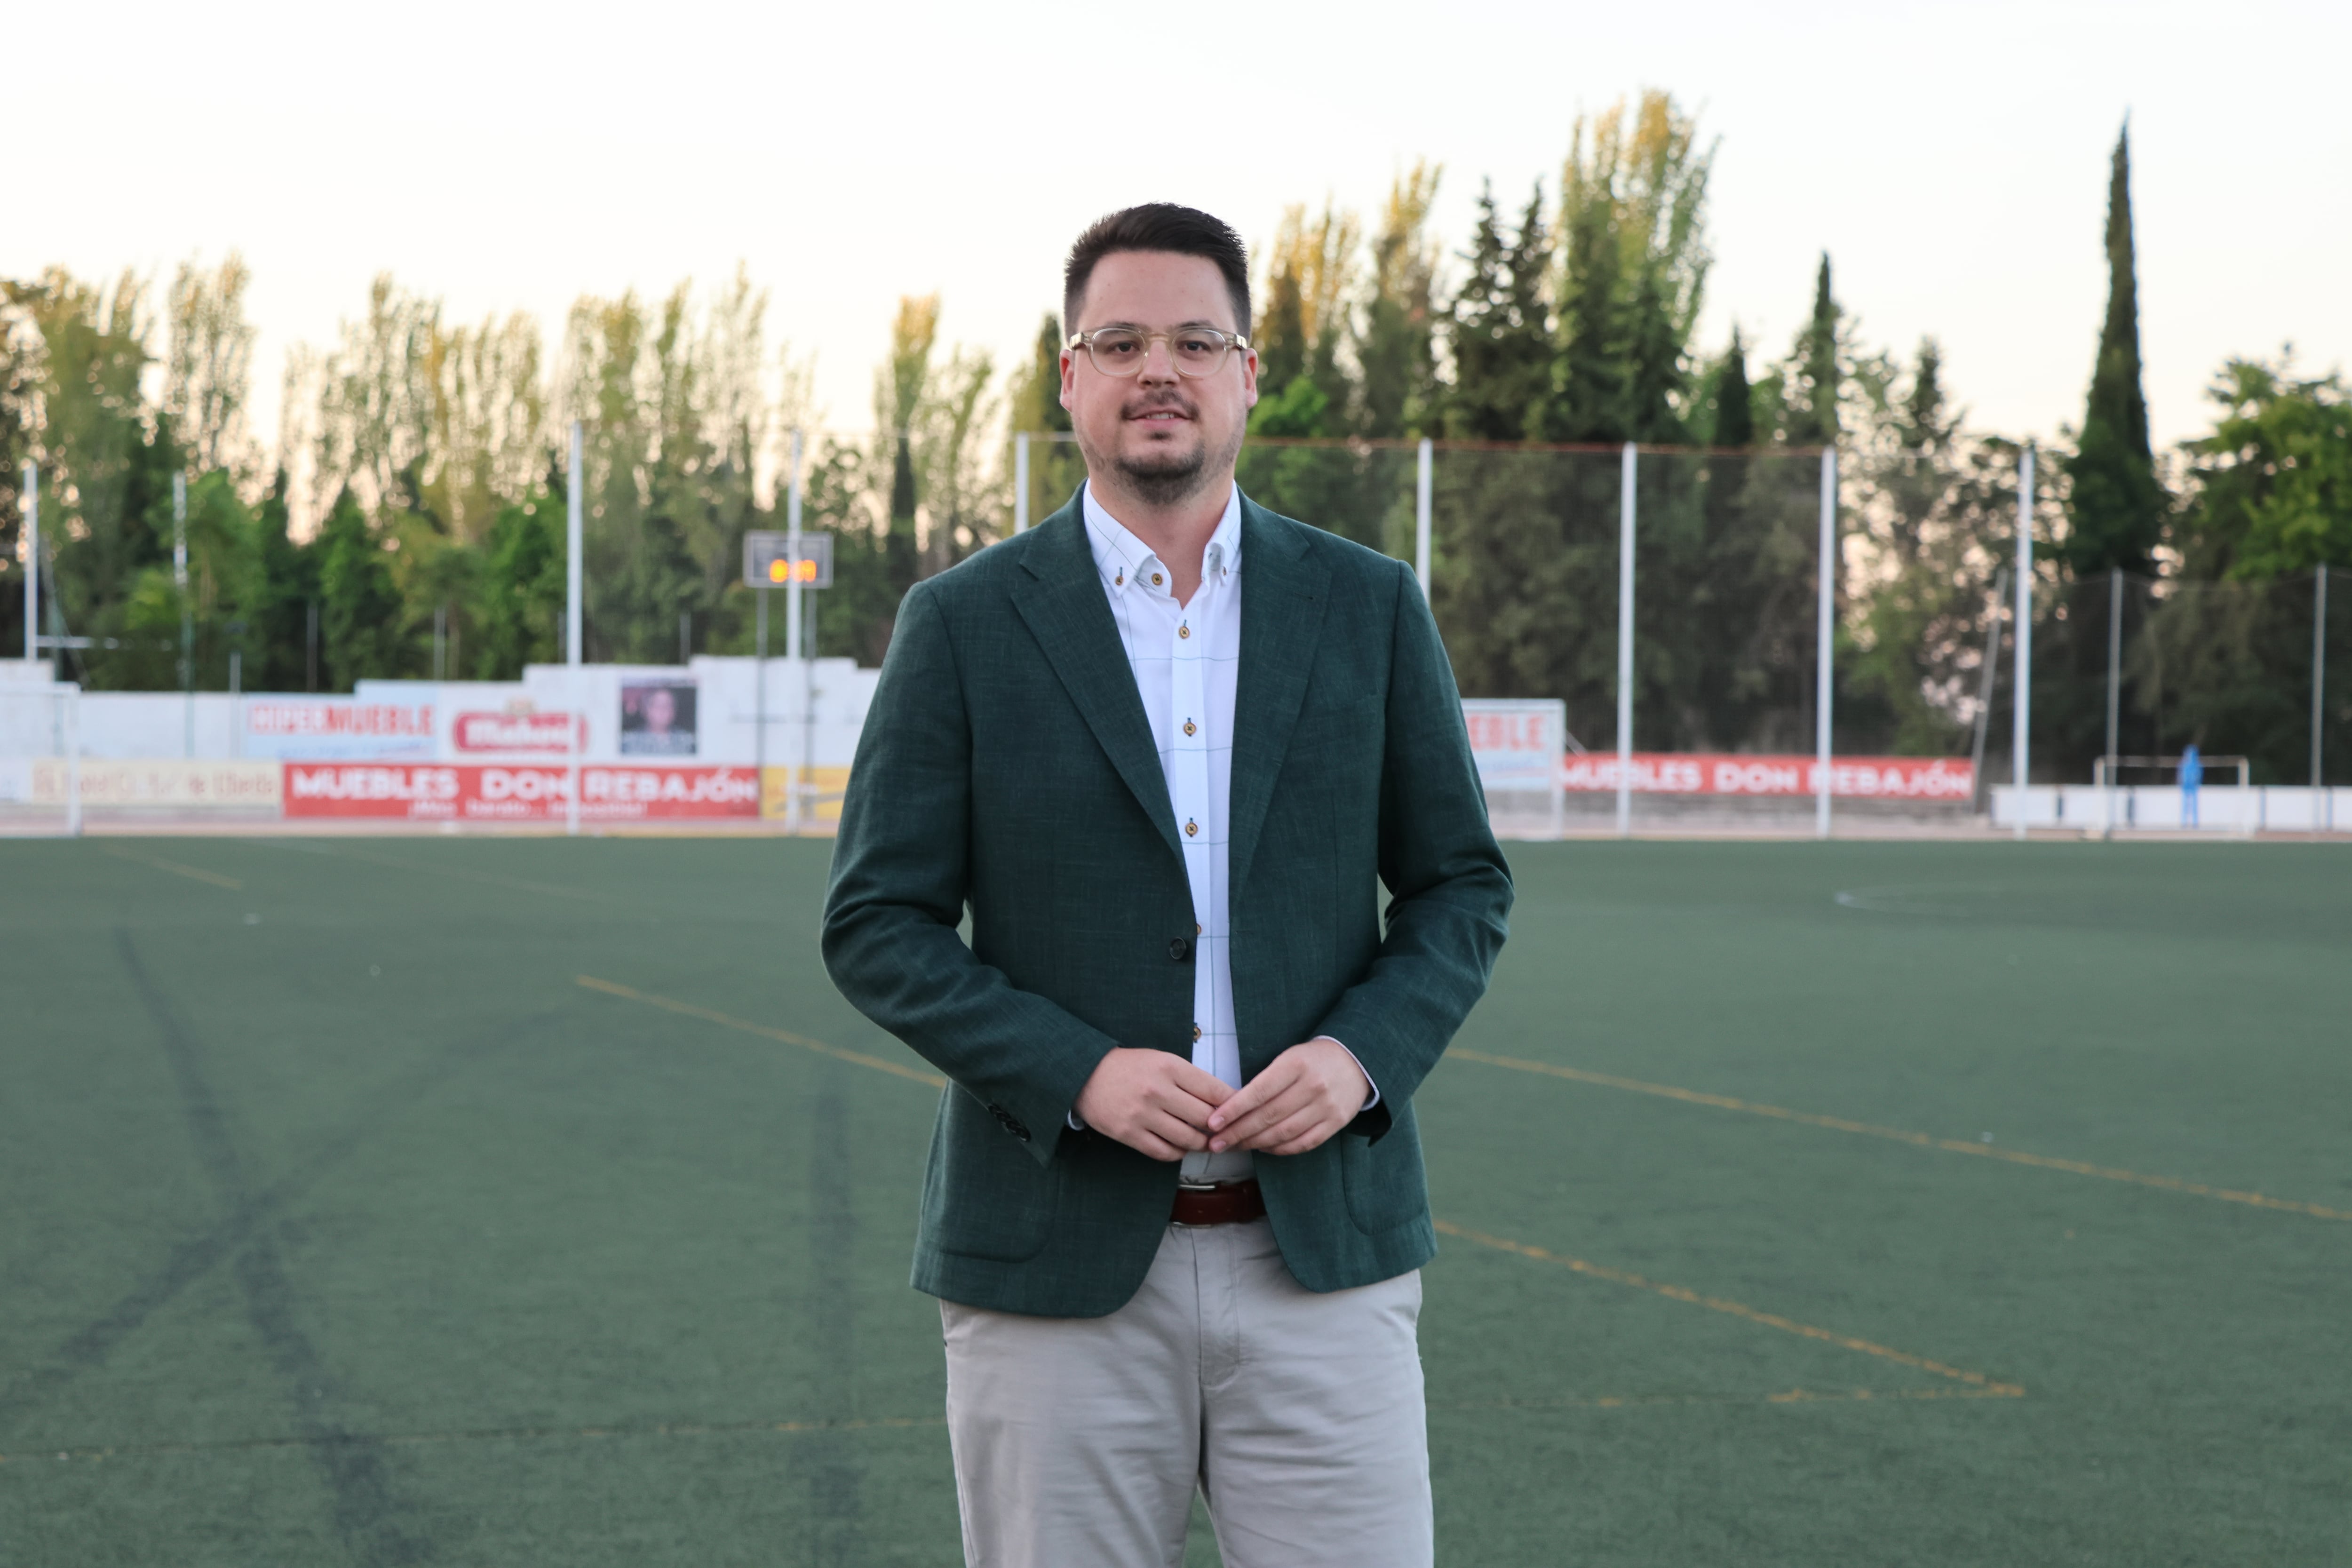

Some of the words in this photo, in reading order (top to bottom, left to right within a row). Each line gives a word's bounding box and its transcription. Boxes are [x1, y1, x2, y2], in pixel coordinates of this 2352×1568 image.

[290, 766, 460, 801] MUEBLES
[481, 769, 574, 802] DON
[584, 765, 759, 803] REBAJÓN
[1713, 761, 1799, 794] DON
